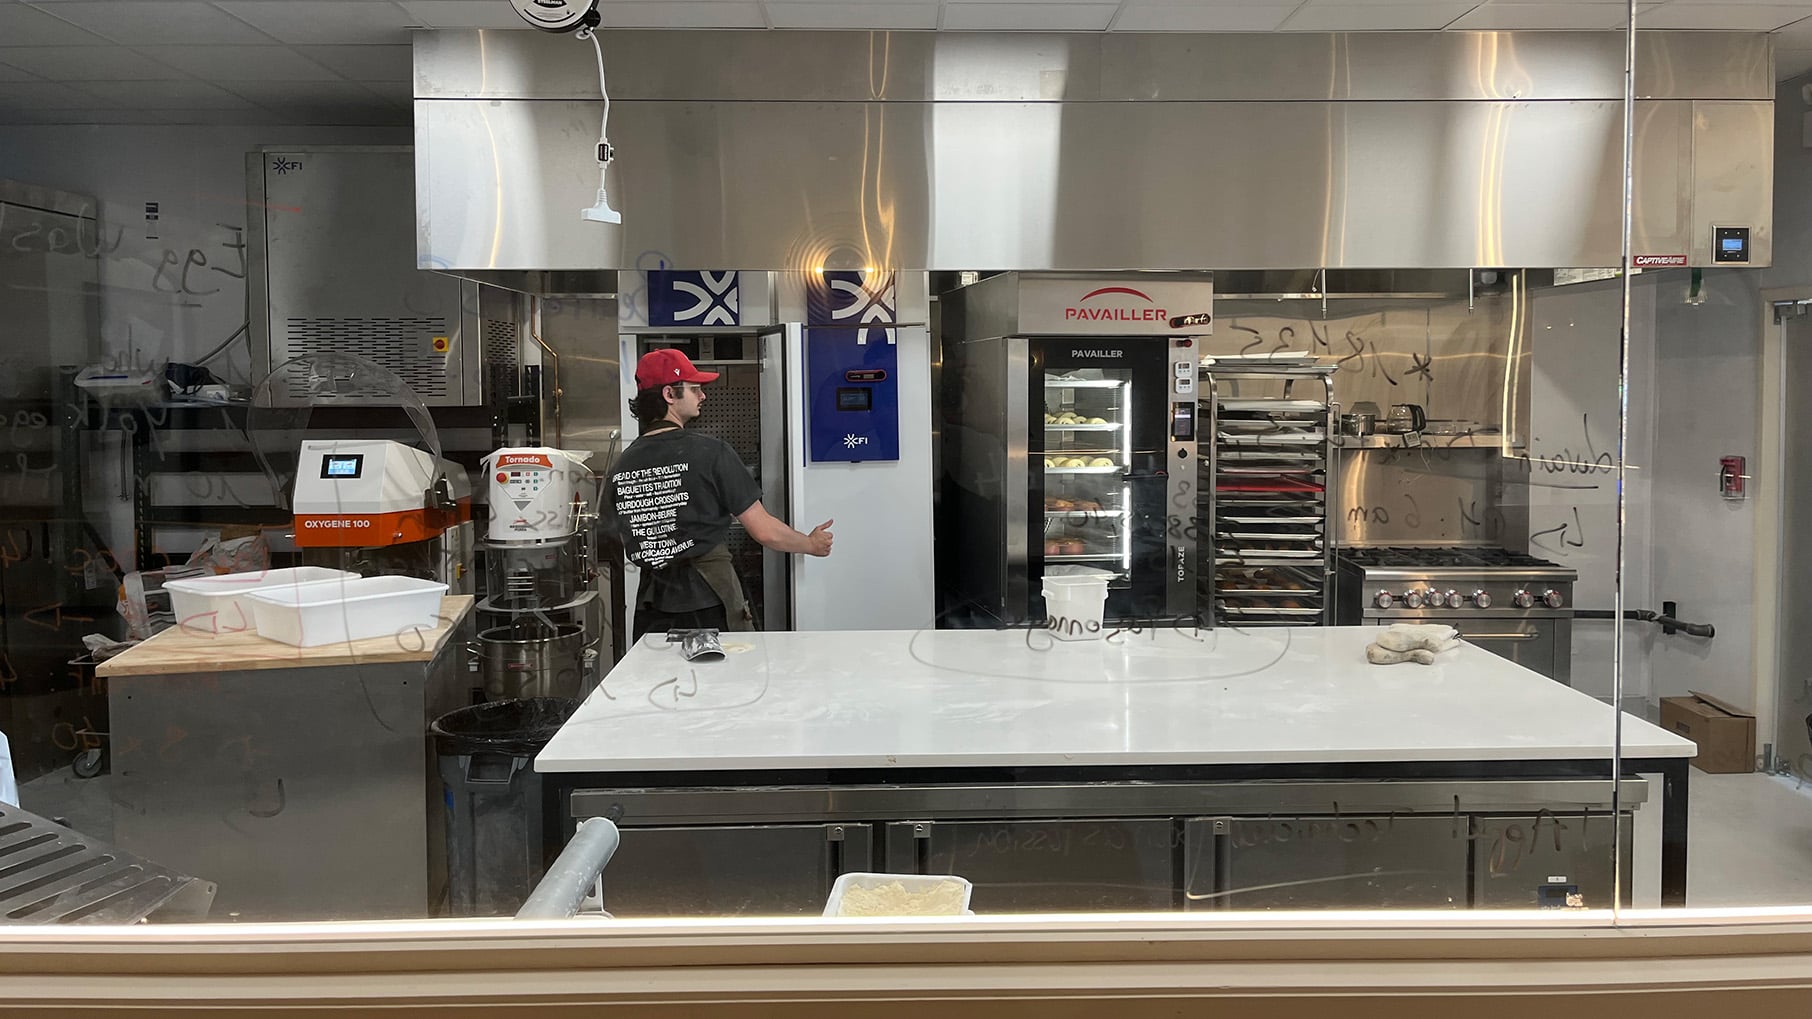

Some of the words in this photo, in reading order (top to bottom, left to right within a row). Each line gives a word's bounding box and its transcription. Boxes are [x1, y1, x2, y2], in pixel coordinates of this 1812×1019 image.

[1065, 308, 1167, 321] PAVAILLER
[1072, 350, 1123, 358] PAVAILLER
[631, 470, 641, 479] OF
[641, 468, 652, 477] THE
[652, 463, 689, 474] REVOLUTION
[617, 484, 654, 495] BAGUETTES
[616, 499, 654, 511] SOURDOUGH
[304, 519, 351, 528] OXYGENE
[353, 519, 370, 528] 100
[632, 528, 646, 536] THE
[641, 547, 671, 557] CHICAGO
[1177, 546, 1185, 583] TOPAZE
